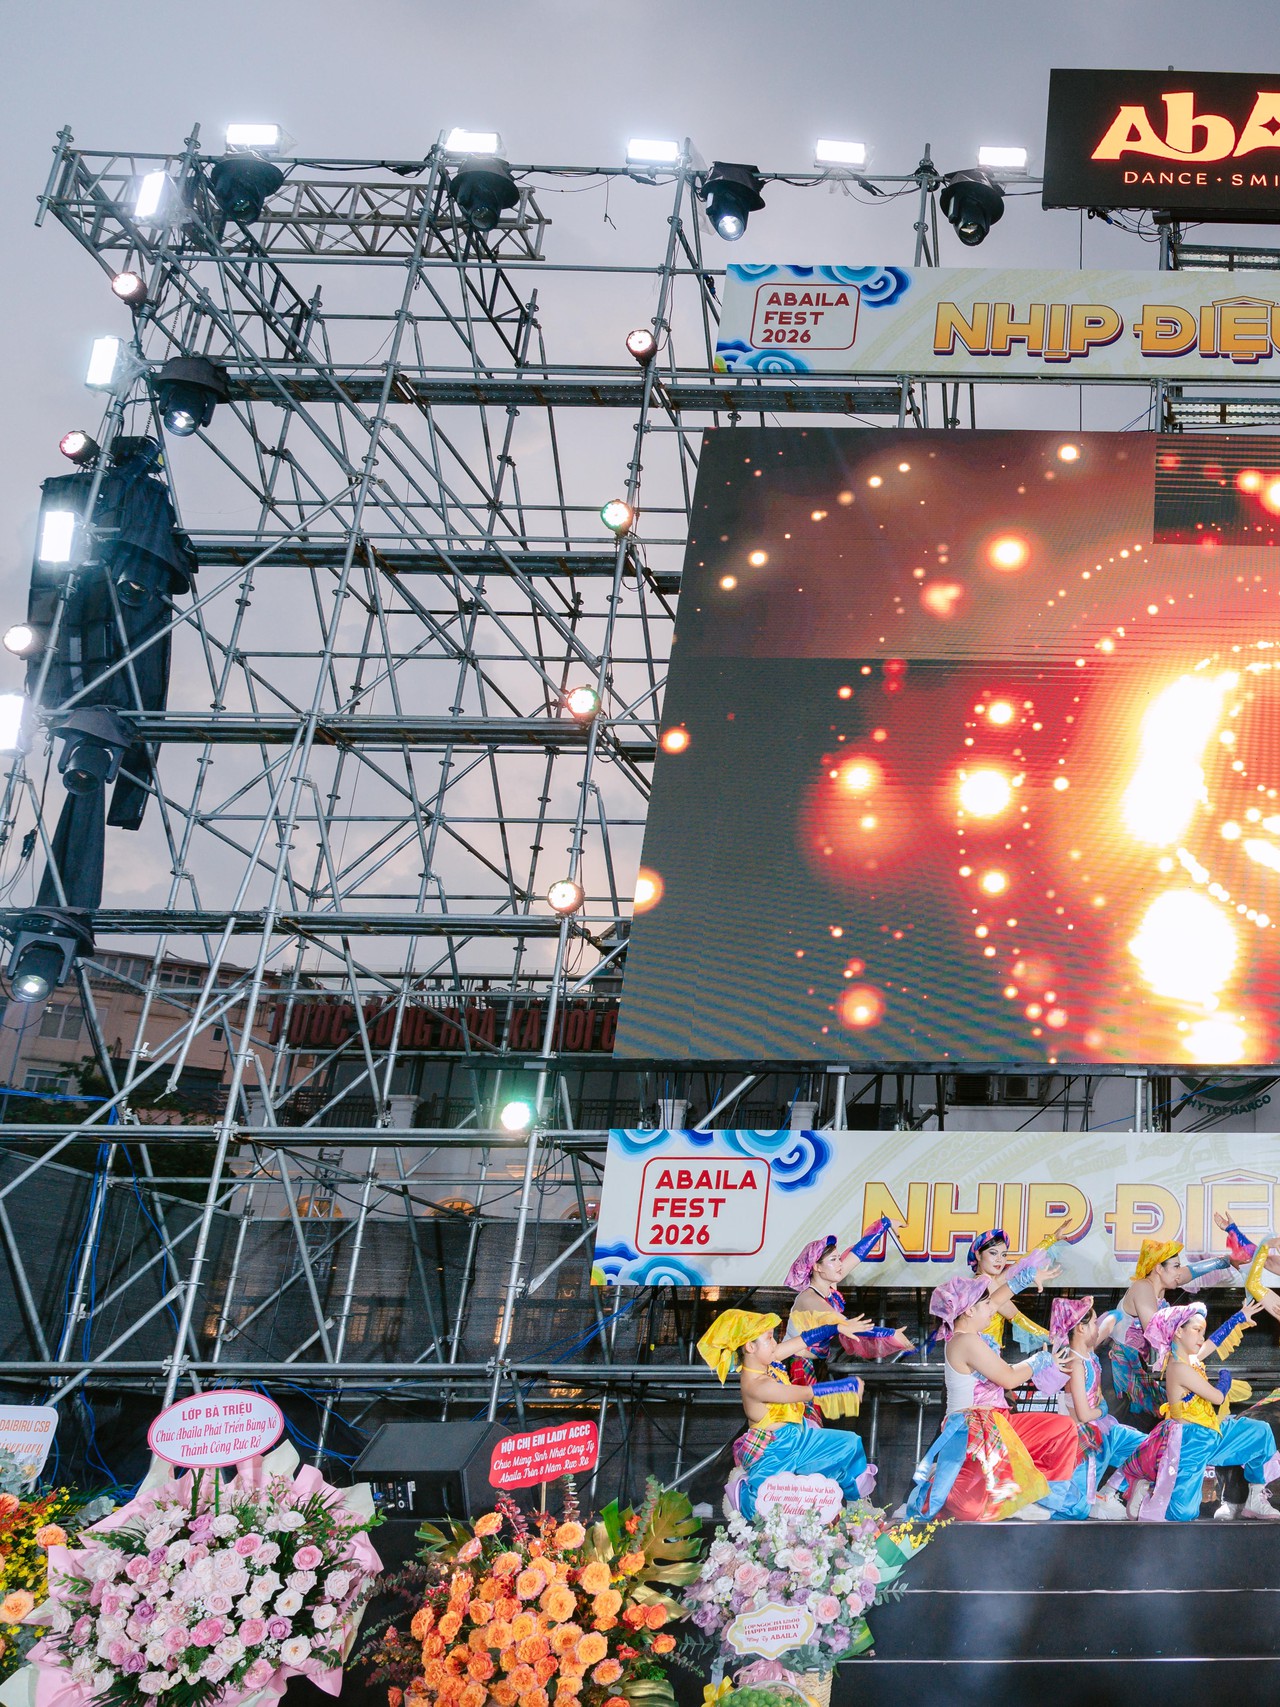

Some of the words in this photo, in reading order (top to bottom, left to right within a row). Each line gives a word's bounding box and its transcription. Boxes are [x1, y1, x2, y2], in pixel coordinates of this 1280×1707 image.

[1123, 171, 1209, 186] DANCE
[766, 292, 850, 306] ABAILA
[764, 311, 825, 326] FEST
[761, 328, 812, 343] 2026
[933, 301, 1124, 363] NHỊP
[655, 1169, 758, 1190] ABAILA
[652, 1197, 727, 1218] FEST
[860, 1181, 1094, 1265] NHỊP
[649, 1224, 711, 1245] 2026
[182, 1407, 202, 1421] LỚP
[205, 1404, 220, 1418] BÀ
[222, 1402, 253, 1417] TRIỆU
[34, 1420, 51, 1433] CSB
[156, 1427, 175, 1443] Chúc
[176, 1425, 203, 1440] Abaila
[203, 1421, 223, 1437] Phát
[246, 1418, 266, 1433] Bùng
[181, 1442, 208, 1457] Thành
[210, 1440, 231, 1454] Công
[233, 1437, 248, 1453] Rực
[501, 1438, 515, 1454] HỘI
[516, 1436, 531, 1450] CHỊ
[532, 1434, 545, 1447] EM
[546, 1429, 568, 1444] LADY
[568, 1424, 591, 1439] ACCC
[493, 1458, 511, 1471] Chúc
[534, 1450, 548, 1463] Sinh
[498, 1470, 522, 1484] Abaila
[744, 1627, 767, 1635] HAPPY
[767, 1623, 800, 1632] BIRTHDAY
[770, 1632, 798, 1640] ABAILA
